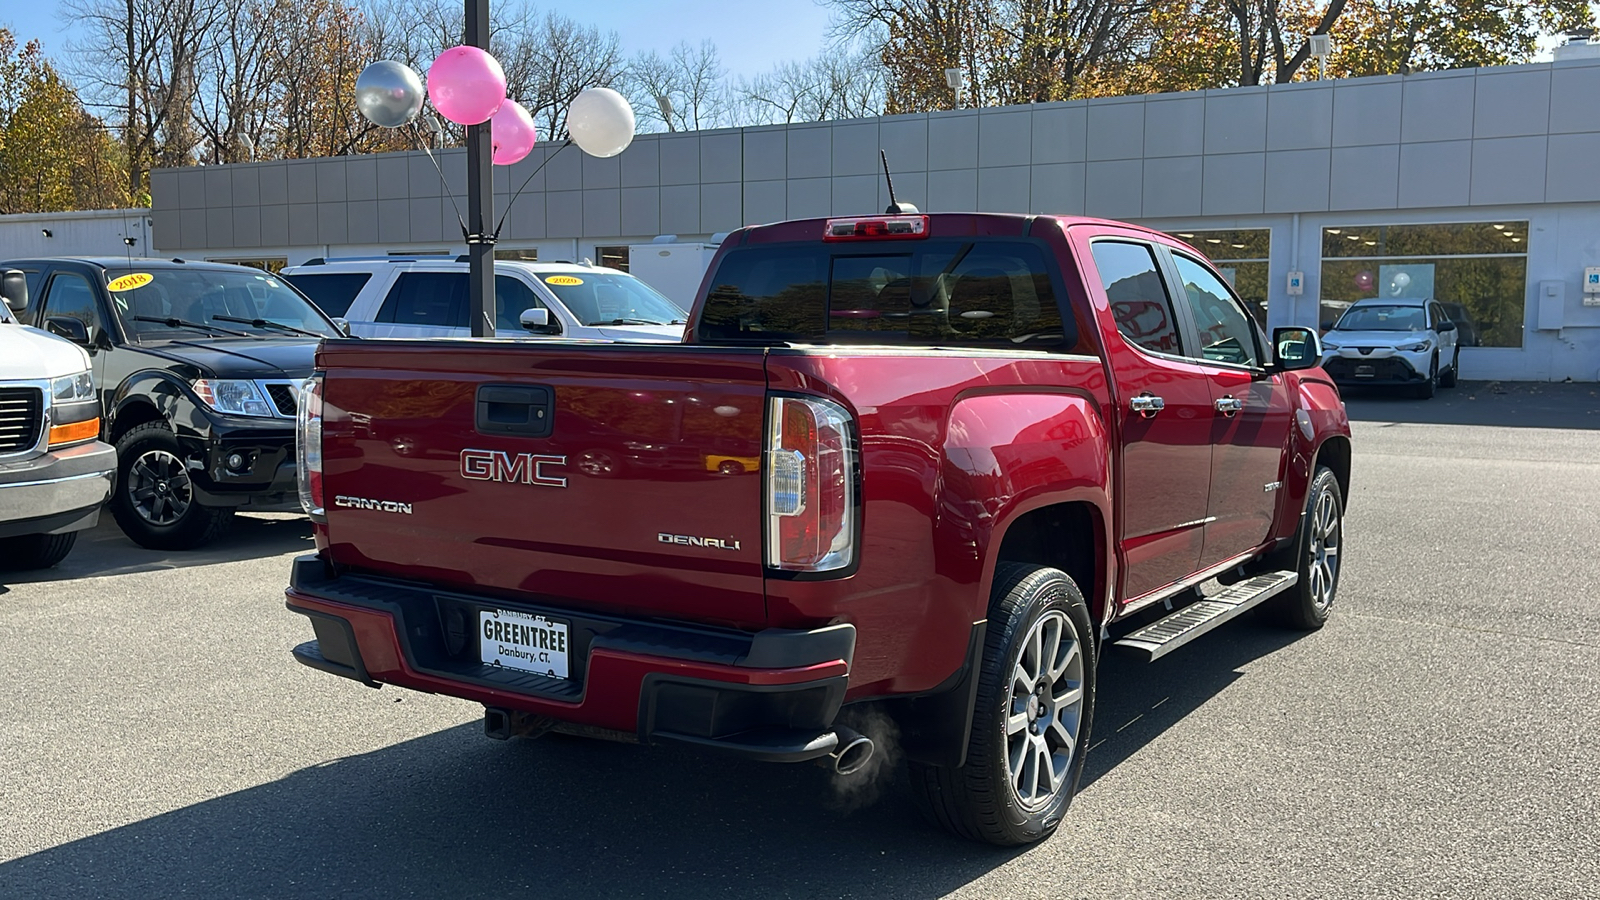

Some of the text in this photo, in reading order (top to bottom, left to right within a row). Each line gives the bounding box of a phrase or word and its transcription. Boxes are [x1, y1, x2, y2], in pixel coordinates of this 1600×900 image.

[115, 275, 147, 290] 2018
[553, 277, 577, 285] 2020
[460, 448, 568, 488] GMC
[335, 495, 412, 514] CANYON
[658, 533, 741, 551] DENALI
[484, 619, 566, 653] GREENTREE
[498, 644, 551, 664] Danbury, CT.
